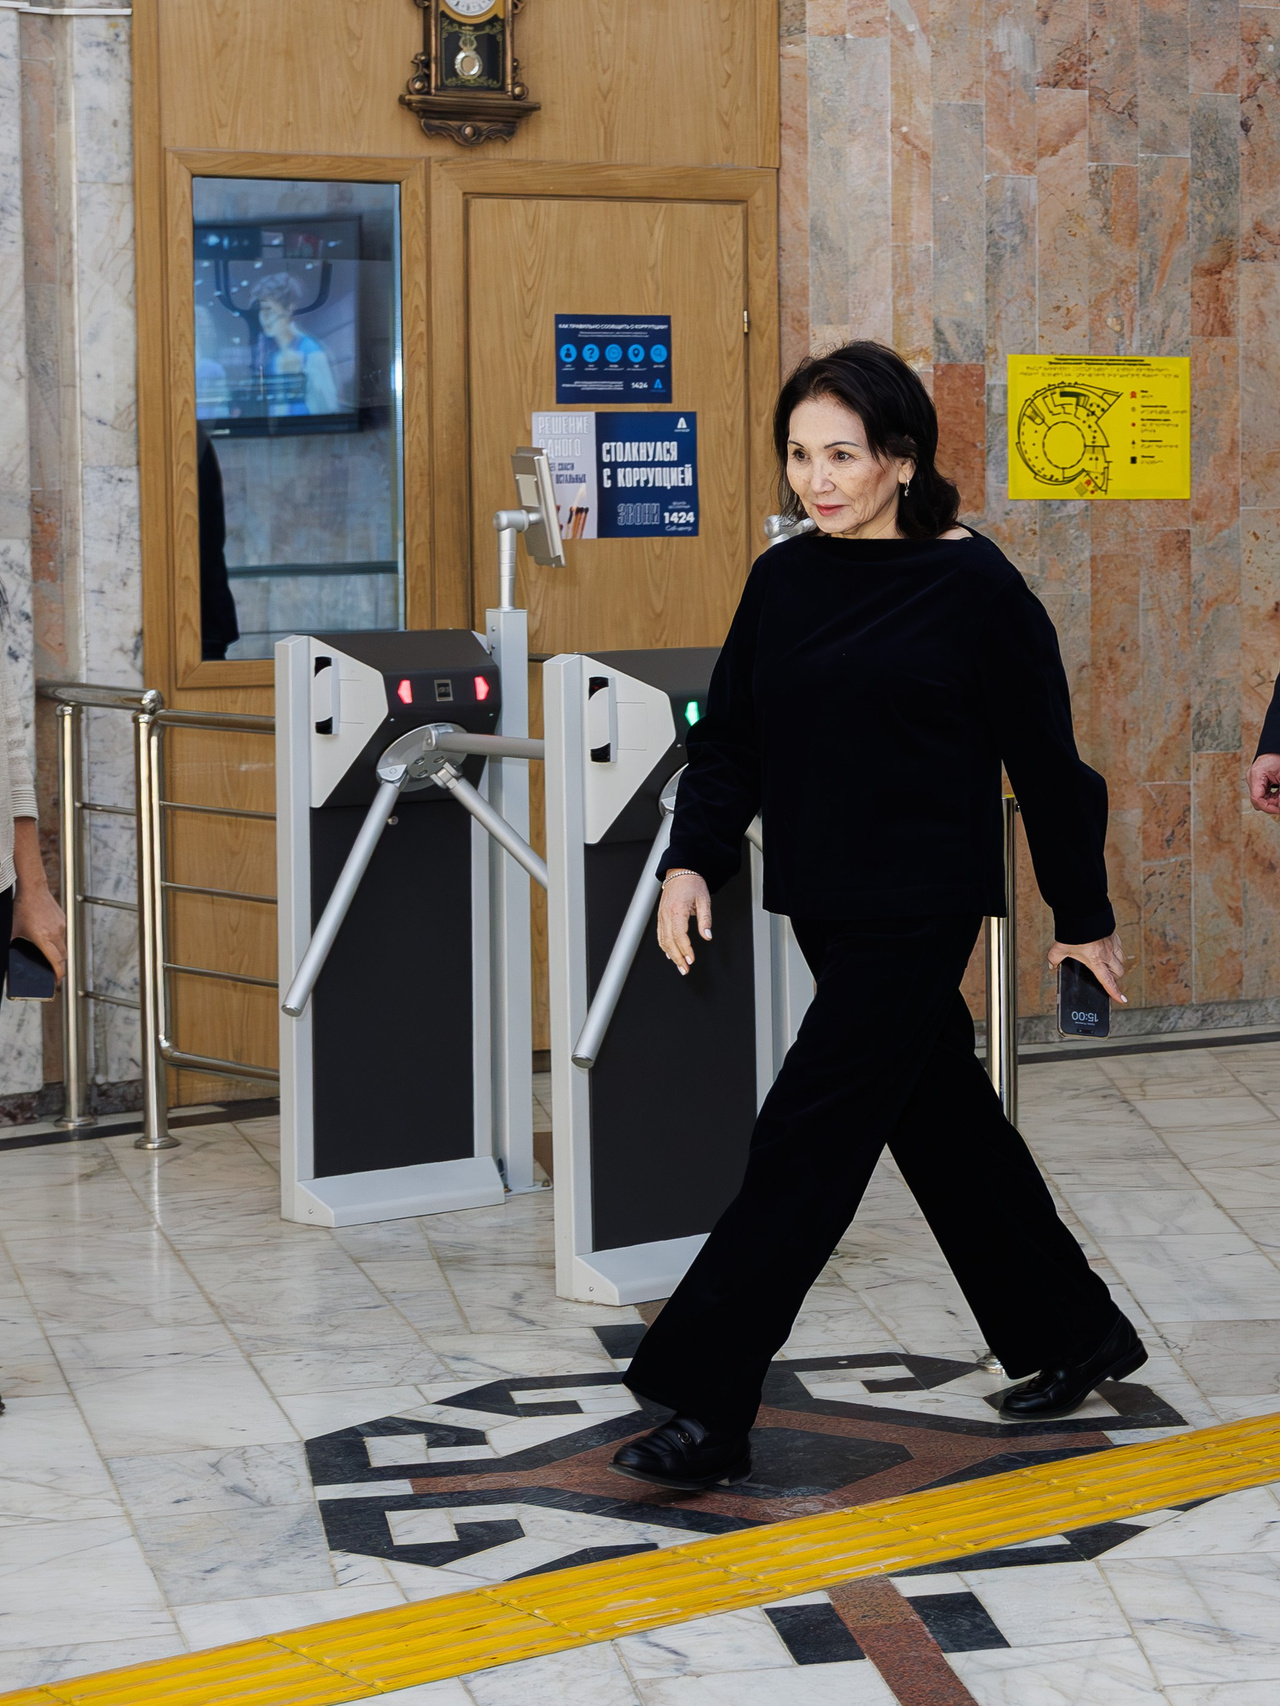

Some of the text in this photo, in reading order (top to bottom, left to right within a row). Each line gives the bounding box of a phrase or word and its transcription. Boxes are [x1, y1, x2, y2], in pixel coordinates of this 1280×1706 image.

[538, 416, 589, 434] РЕШЕНИЕ
[602, 441, 678, 462] СТОЛКНУЛСЯ
[602, 464, 693, 489] С КОРРУПЦИЕЙ
[617, 503, 660, 526] ЗВОНИ
[663, 511, 695, 524] 1424
[1071, 1011, 1099, 1022] 15:00
